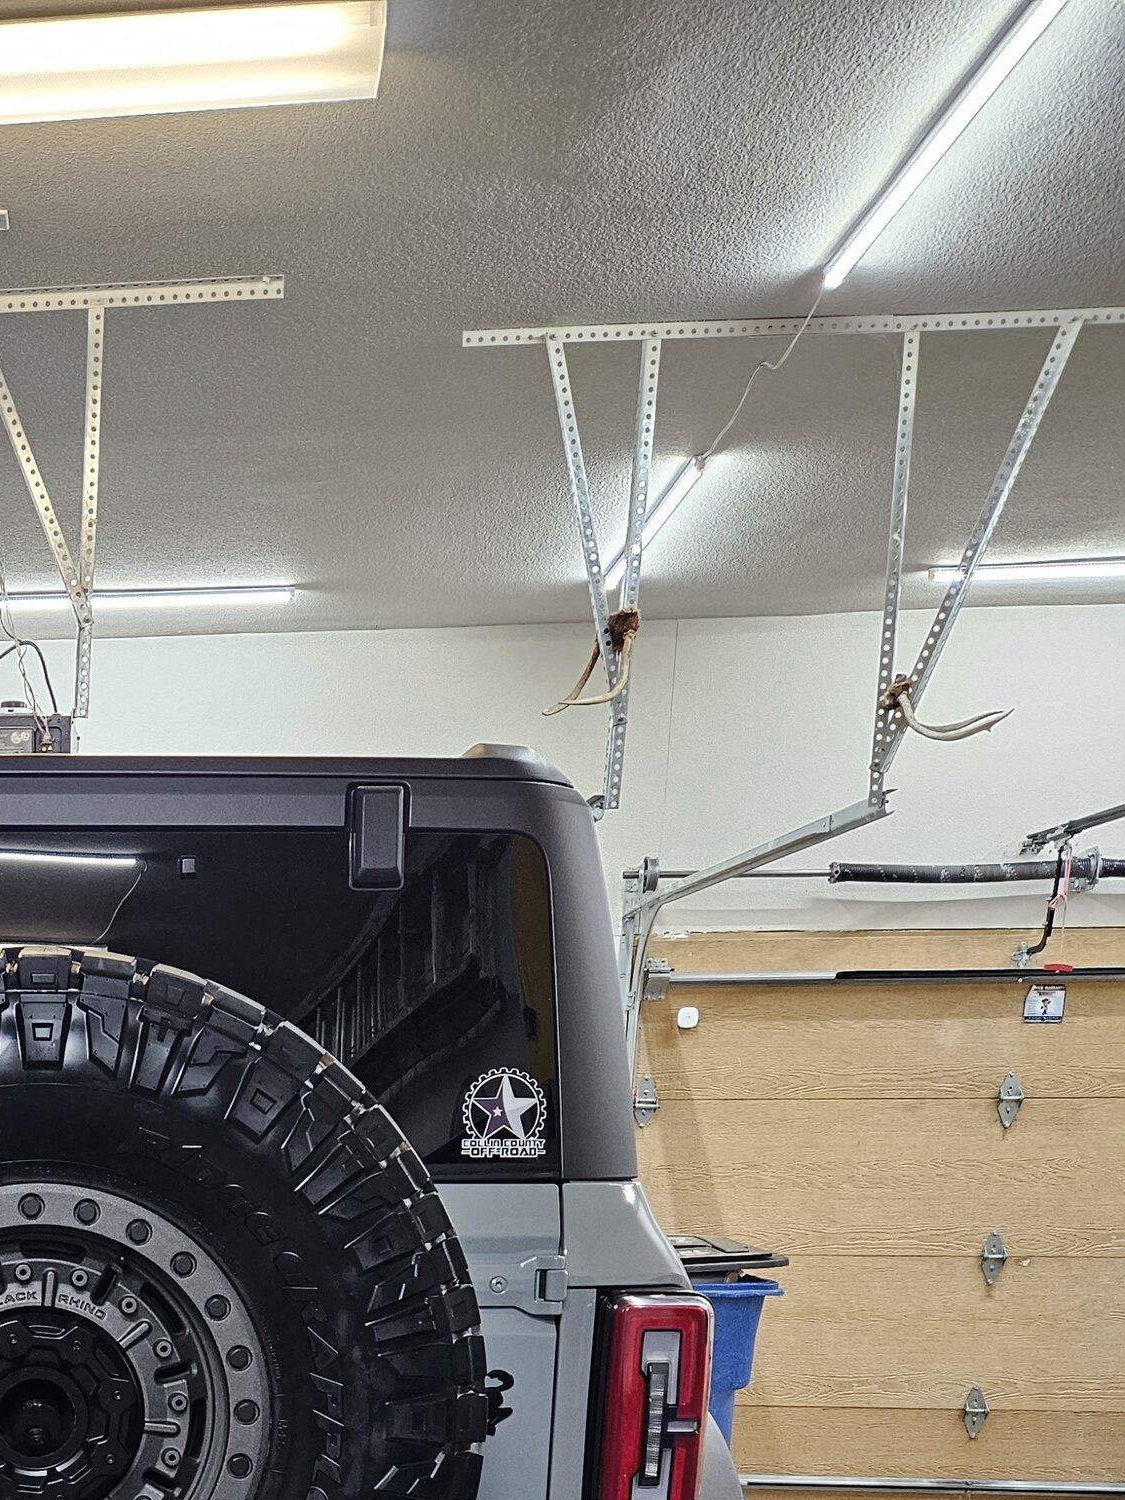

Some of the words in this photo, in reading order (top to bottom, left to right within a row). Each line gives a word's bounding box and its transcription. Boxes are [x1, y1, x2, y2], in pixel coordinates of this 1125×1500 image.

[462, 1138, 501, 1148] COLLIN
[502, 1138, 546, 1149] COUNTY
[470, 1147, 538, 1158] OFF-ROAD
[58, 1293, 107, 1321] RHINO
